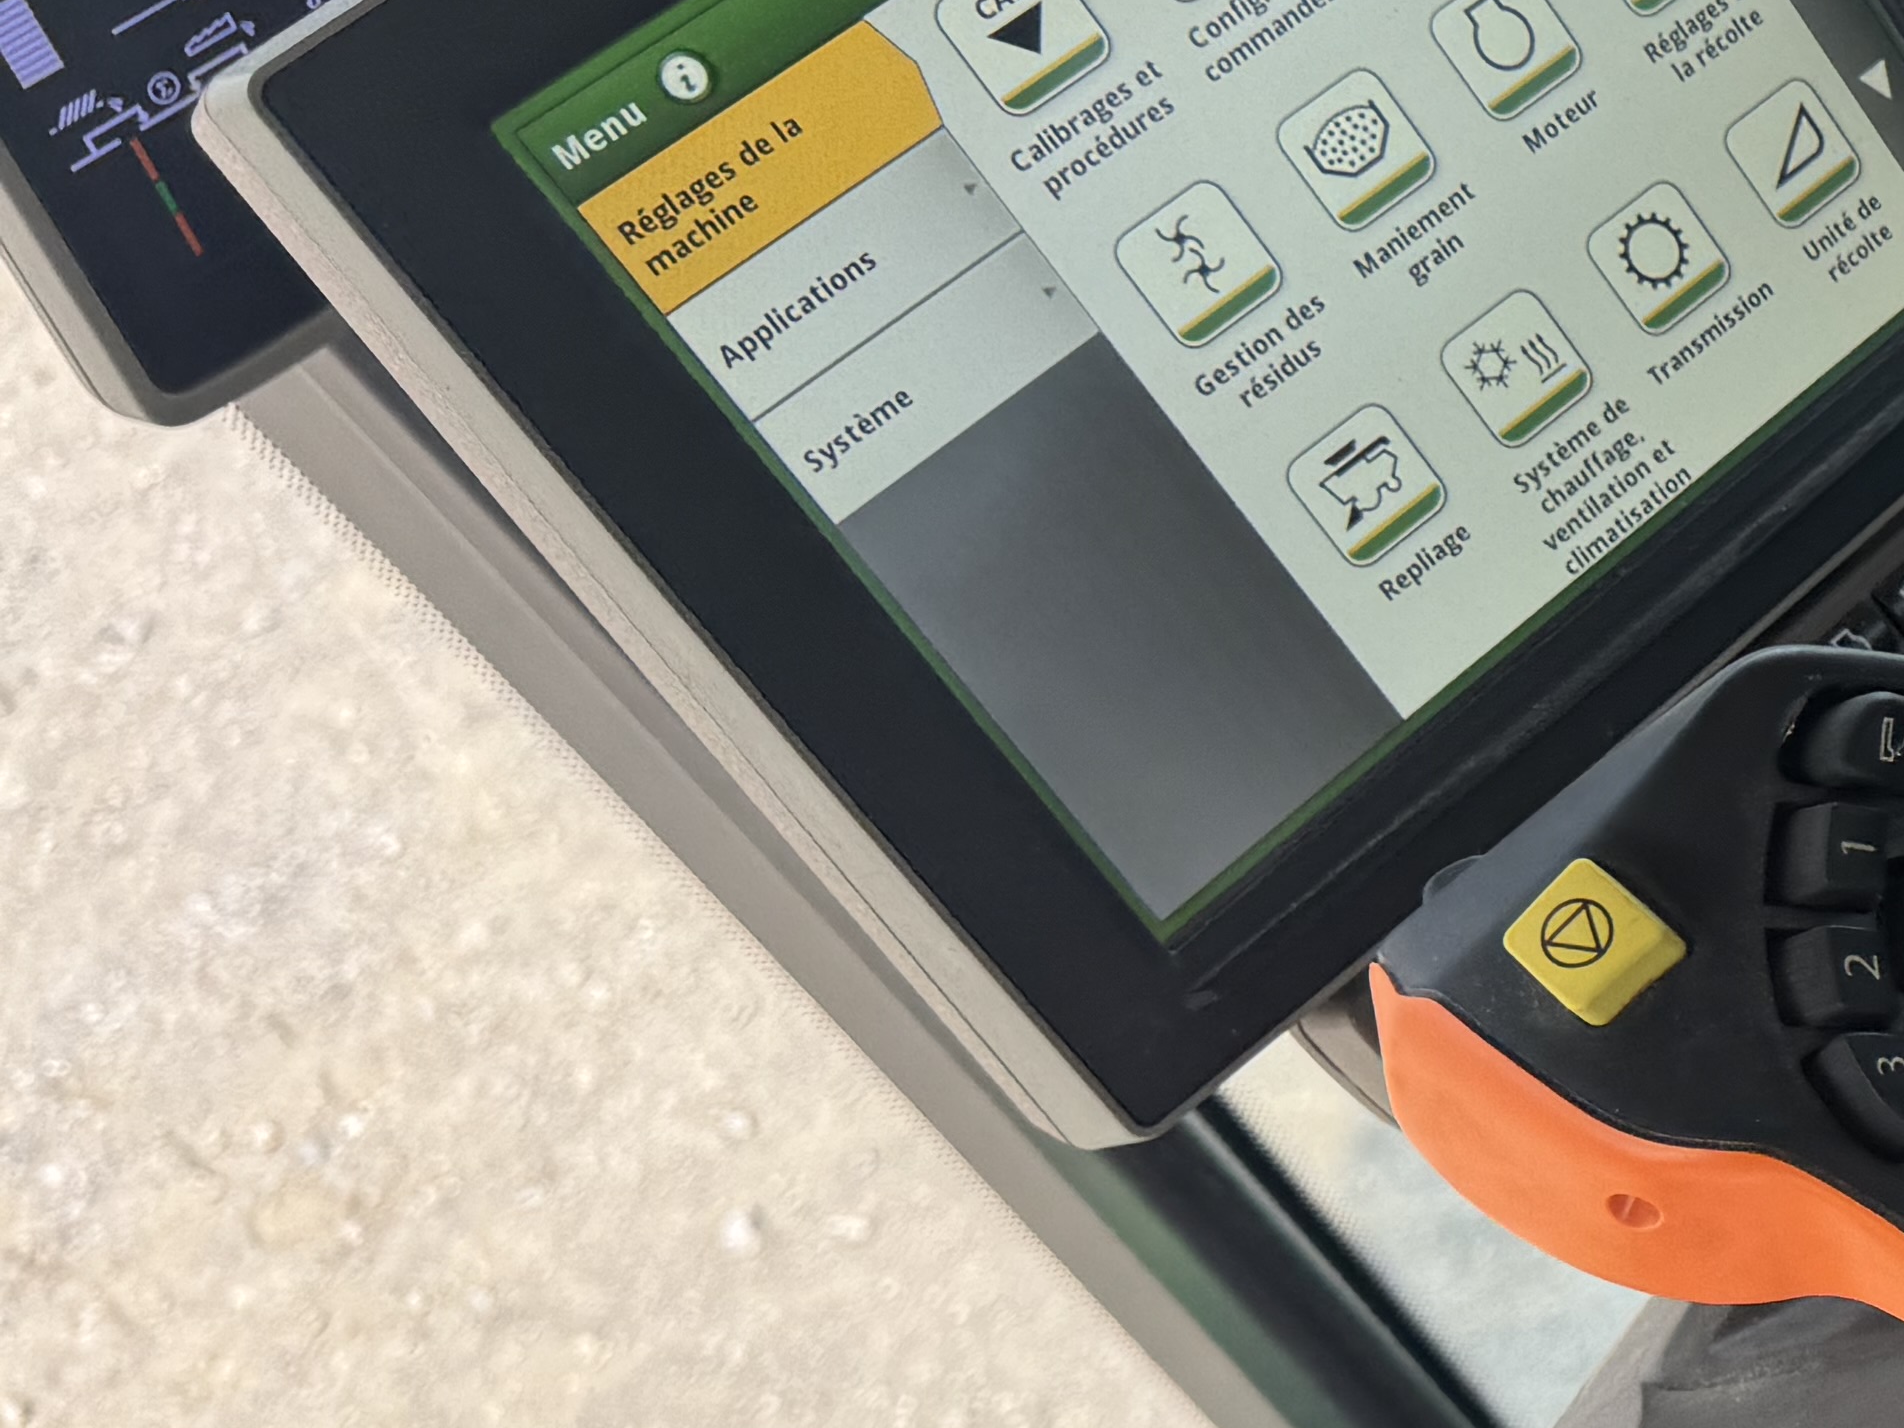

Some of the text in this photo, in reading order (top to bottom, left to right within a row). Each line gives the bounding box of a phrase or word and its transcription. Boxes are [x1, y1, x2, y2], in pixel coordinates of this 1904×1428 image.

[1671, 8, 1764, 83] la récolte
[551, 101, 648, 171] Menu
[1010, 60, 1164, 172] Calibrages et
[1043, 95, 1175, 200] procédures
[1521, 89, 1598, 154] Moteur
[617, 116, 804, 246] Réglages de la
[644, 191, 759, 276] machine
[1352, 181, 1476, 279] Maniement
[1408, 234, 1465, 287] grain
[1802, 195, 1882, 261] Unité de
[1828, 224, 1893, 283] récolte
[719, 252, 877, 369] Applications
[1194, 295, 1326, 396] Gestion des
[1646, 282, 1775, 385] Transmission
[1239, 340, 1322, 408] résidus
[803, 390, 914, 473] Système
[1513, 398, 1631, 494] Système de
[1541, 431, 1646, 514] chauffage,
[1542, 438, 1676, 551] ventilation et
[1565, 467, 1692, 575] climatisation
[1378, 525, 1471, 601] Repliage
[1841, 840, 1878, 855] 1
[1844, 954, 1880, 980] 2
